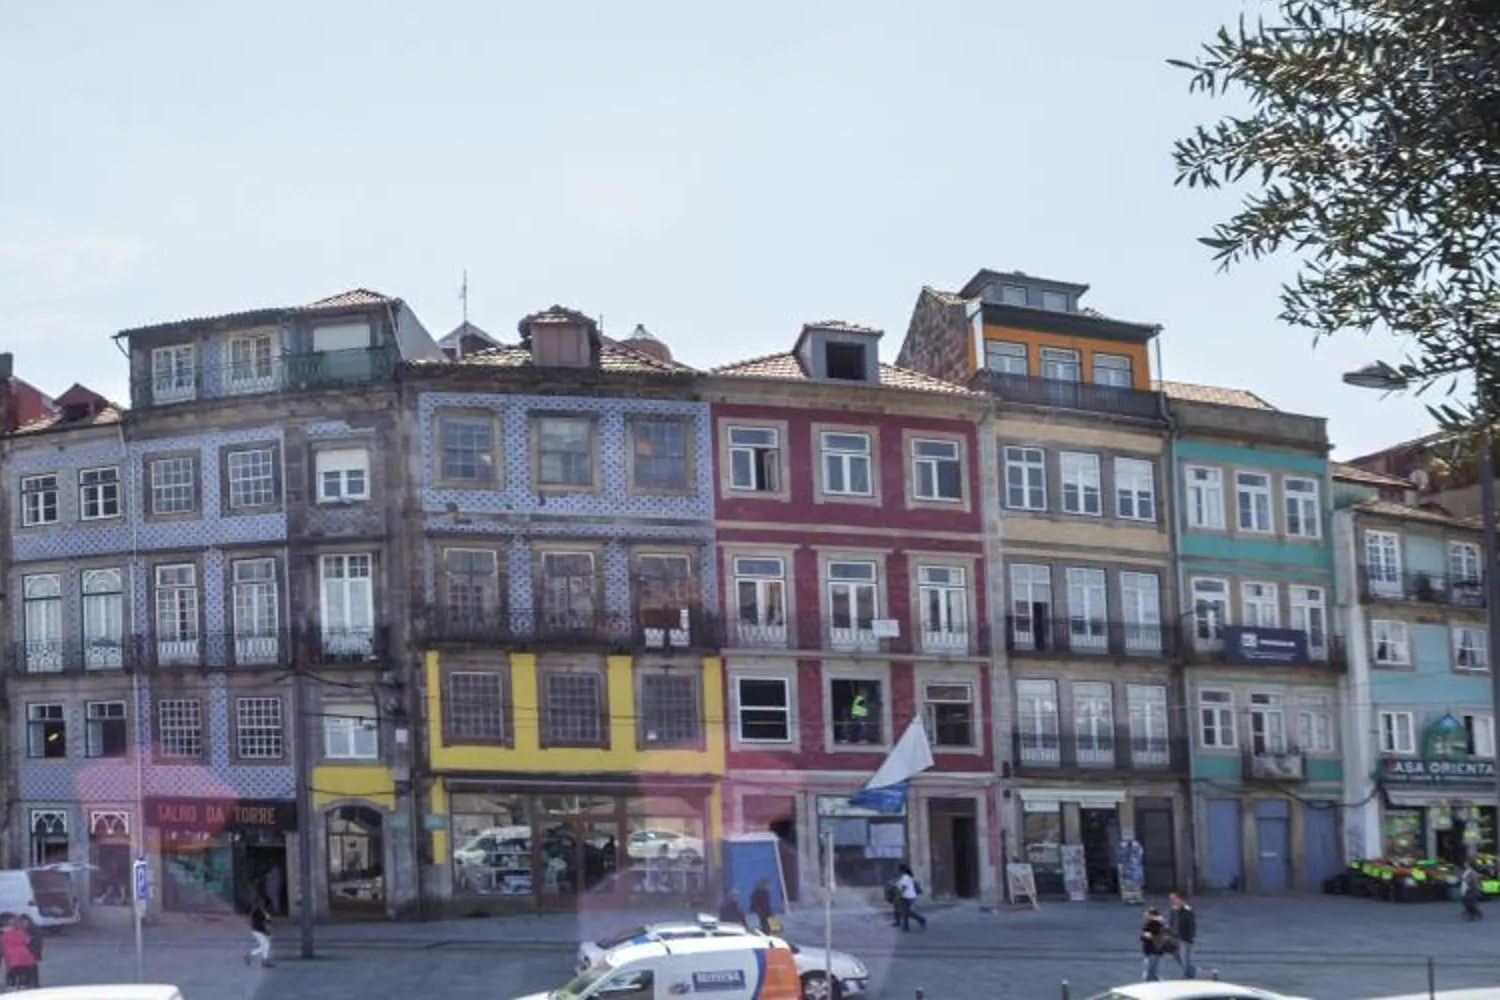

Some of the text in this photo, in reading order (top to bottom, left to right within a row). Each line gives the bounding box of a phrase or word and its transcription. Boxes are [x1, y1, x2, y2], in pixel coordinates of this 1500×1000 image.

[1428, 762, 1494, 774] ORIENTA
[205, 804, 226, 825] DA
[233, 805, 277, 825] TORRE
